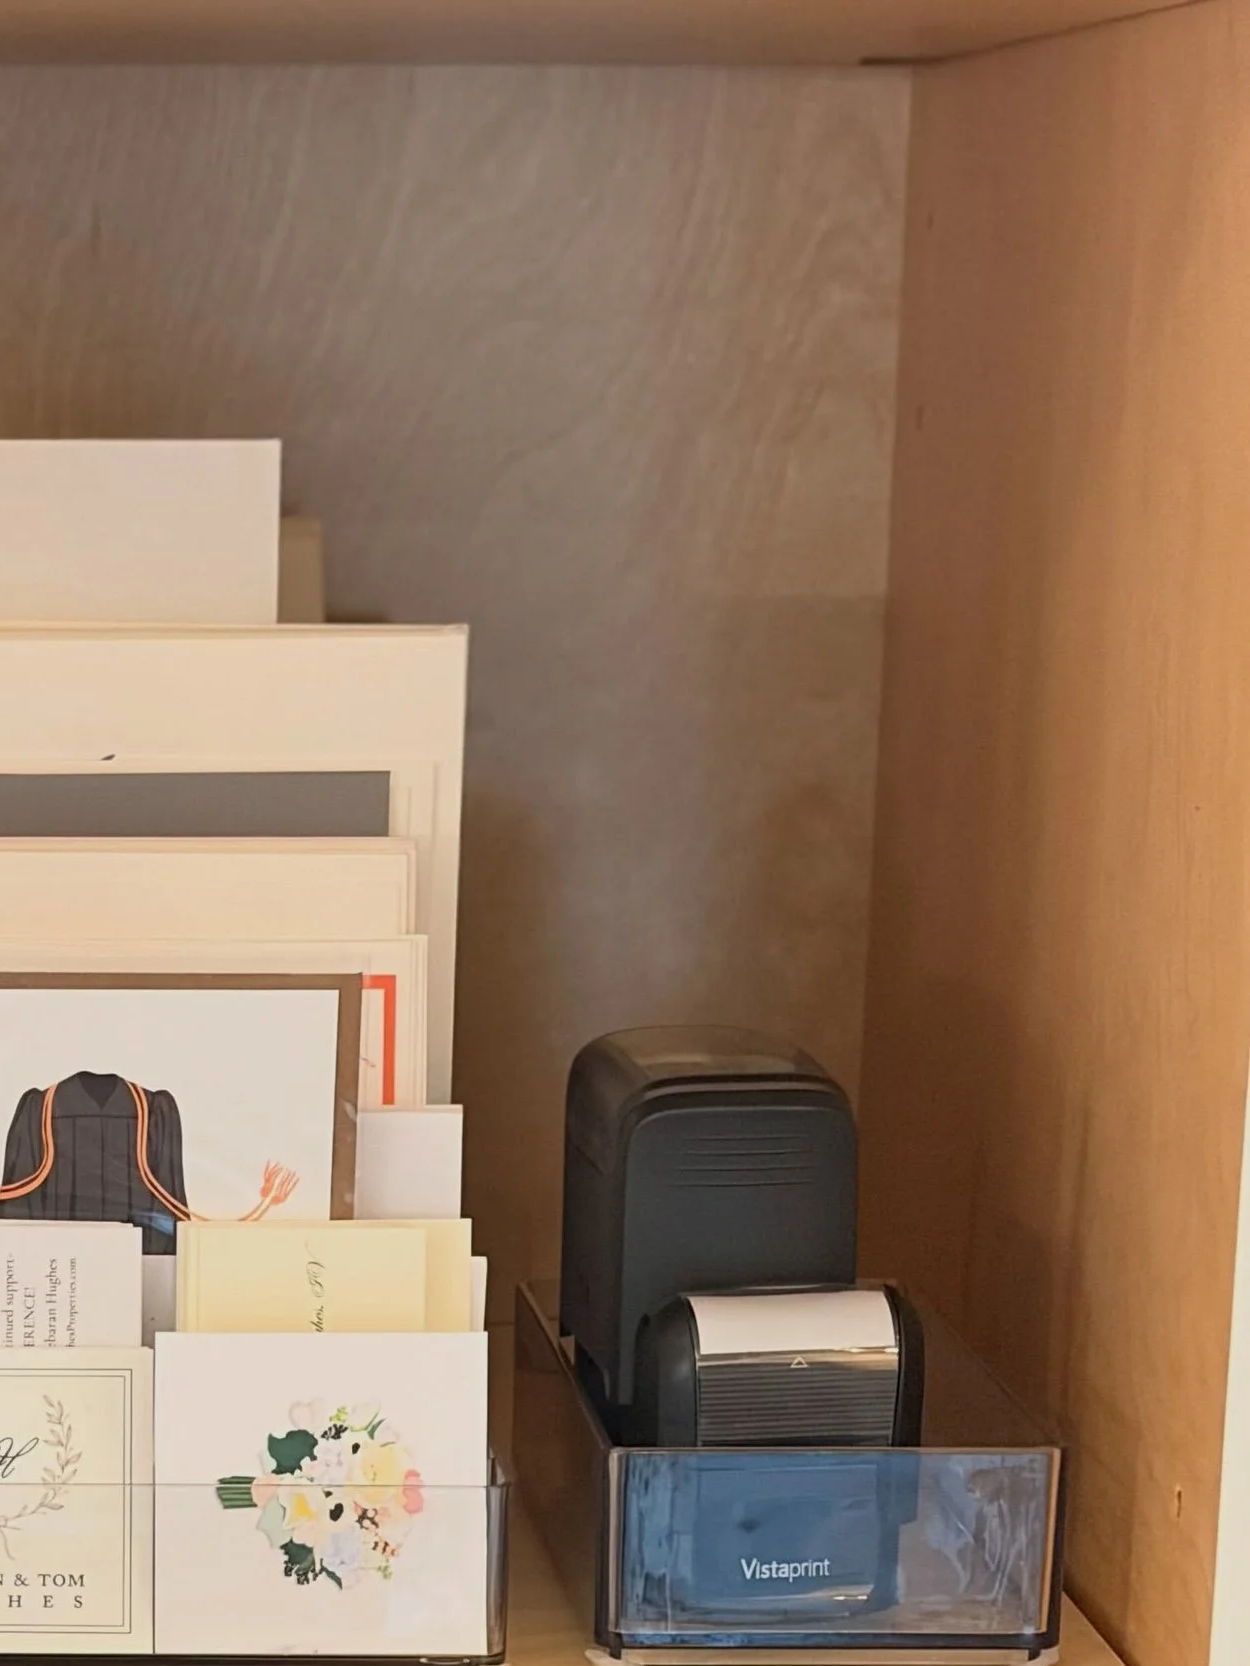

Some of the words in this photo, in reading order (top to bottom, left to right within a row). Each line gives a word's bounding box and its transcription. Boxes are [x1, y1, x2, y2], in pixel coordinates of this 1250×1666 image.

[45, 1258, 61, 1304] Hughes
[13, 1572, 30, 1588] &
[37, 1572, 86, 1588] TOM
[740, 1557, 831, 1583] Vistaprint
